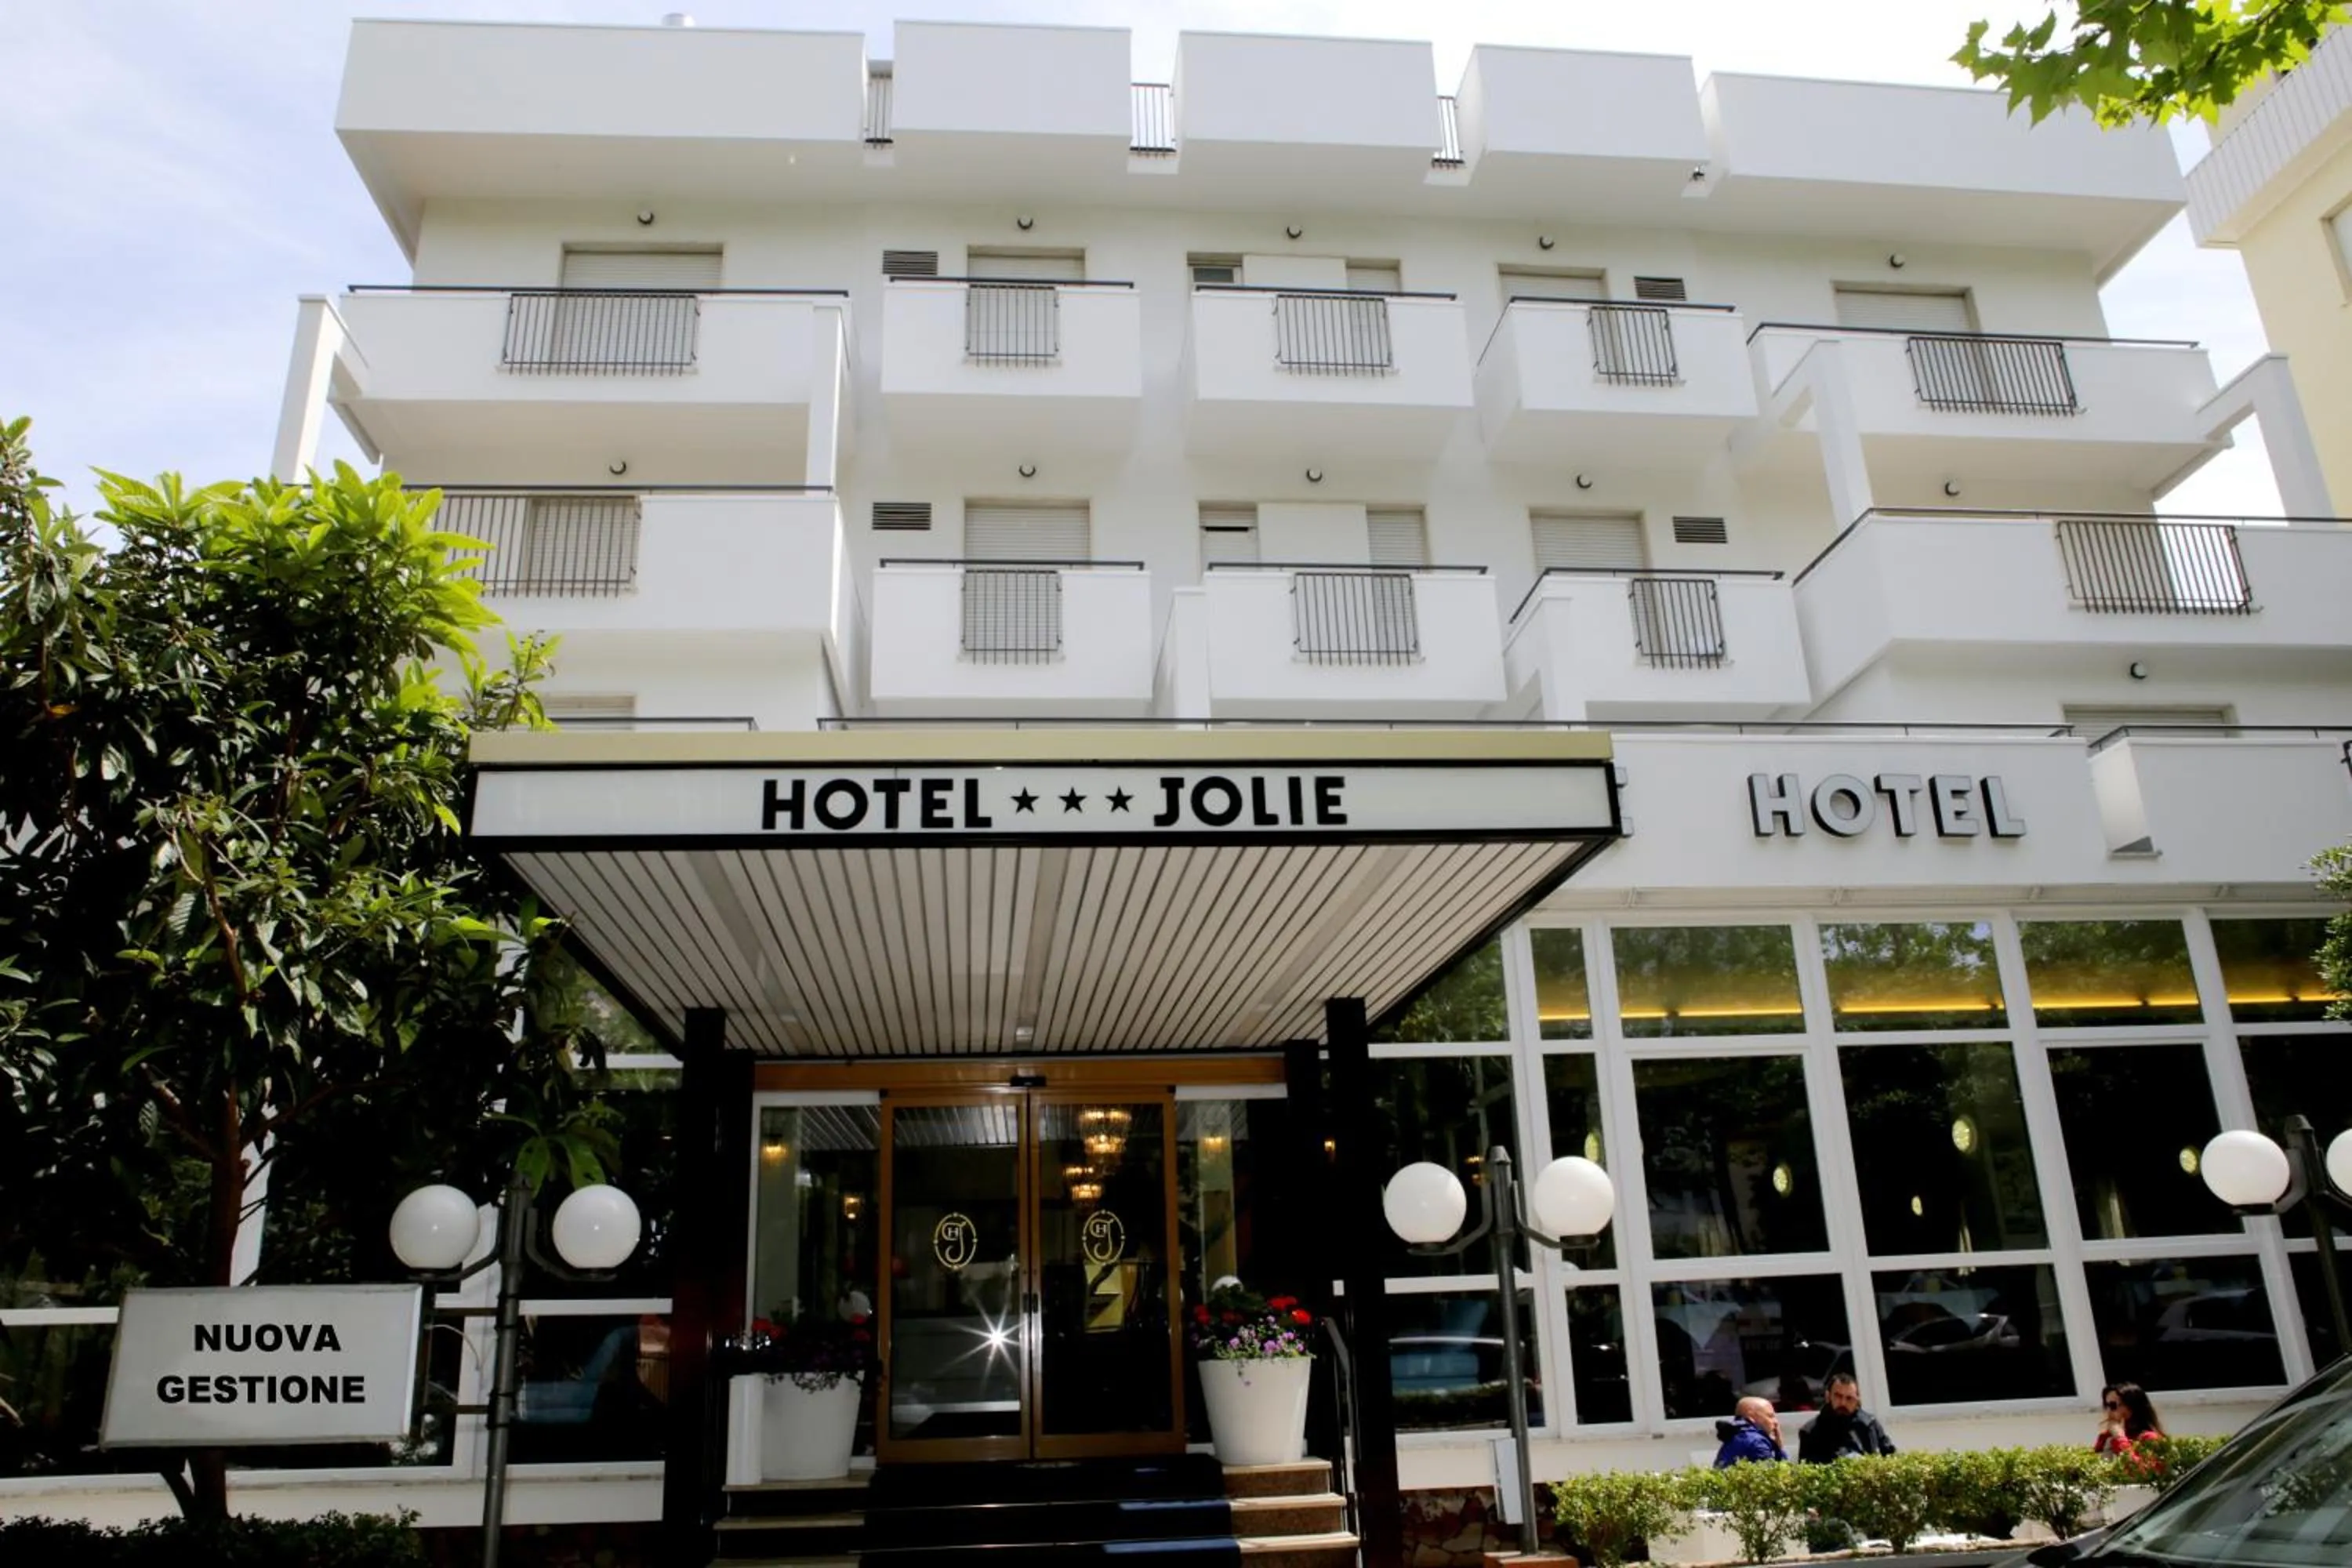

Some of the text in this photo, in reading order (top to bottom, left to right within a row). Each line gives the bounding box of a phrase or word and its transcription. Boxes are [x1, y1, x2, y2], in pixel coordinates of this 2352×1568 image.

[762, 775, 1348, 830] HOTEL JOLIE
[1747, 773, 2027, 839] HOTEL
[194, 1324, 342, 1352] NUOVA
[157, 1375, 366, 1404] GESTIONE
